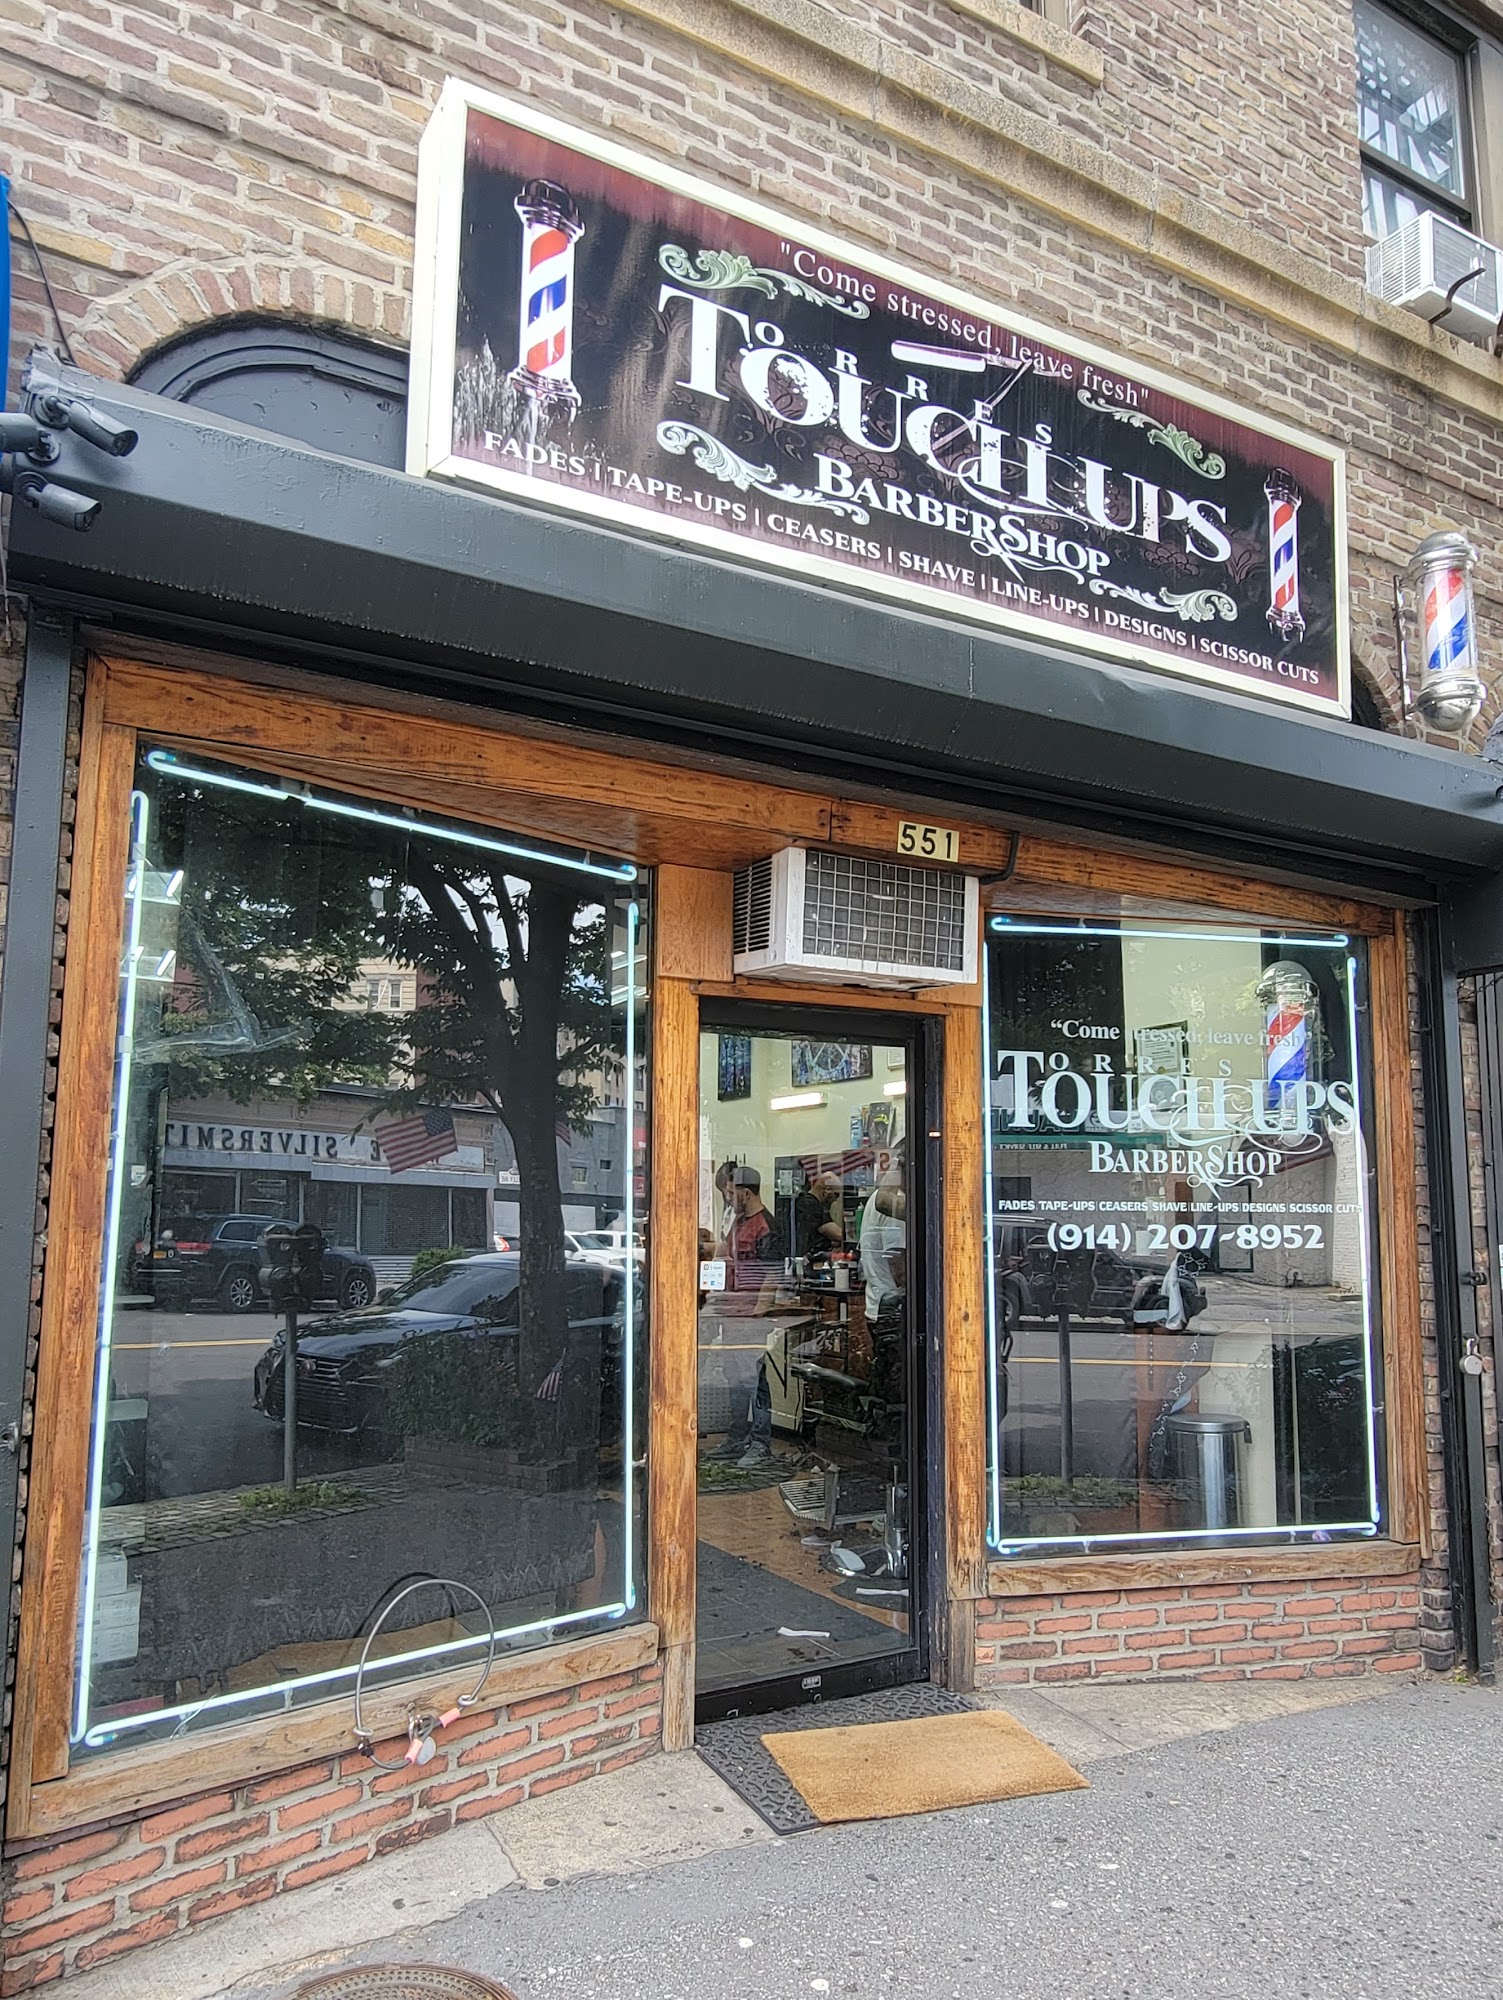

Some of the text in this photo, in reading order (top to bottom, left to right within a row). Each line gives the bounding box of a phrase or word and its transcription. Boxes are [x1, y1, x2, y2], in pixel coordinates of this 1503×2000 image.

[780, 240, 1149, 408] "Come stressed, leave fresh"
[811, 452, 1111, 579] BARBERSHOP
[1077, 453, 1233, 564] UPS
[484, 429, 1320, 686] FADES TAPE-UPS CEASERS SHAVE LINE-UPS DESIGNS SCISSOR CUTS
[901, 825, 952, 859] 551
[1208, 1028, 1254, 1045] leave
[1088, 1141, 1282, 1180] BARBERSHOP
[998, 1200, 1036, 1212] FADES
[1039, 1201, 1096, 1212] TAPE-UPS
[1099, 1201, 1149, 1212] CEASERS
[1152, 1202, 1188, 1212] SHAVE
[1190, 1202, 1239, 1213] LINE-UPS
[1242, 1203, 1287, 1213] DESIGNS
[1289, 1203, 1333, 1214] SCISSOR
[1047, 1222, 1325, 1252] (914) 207-8952
